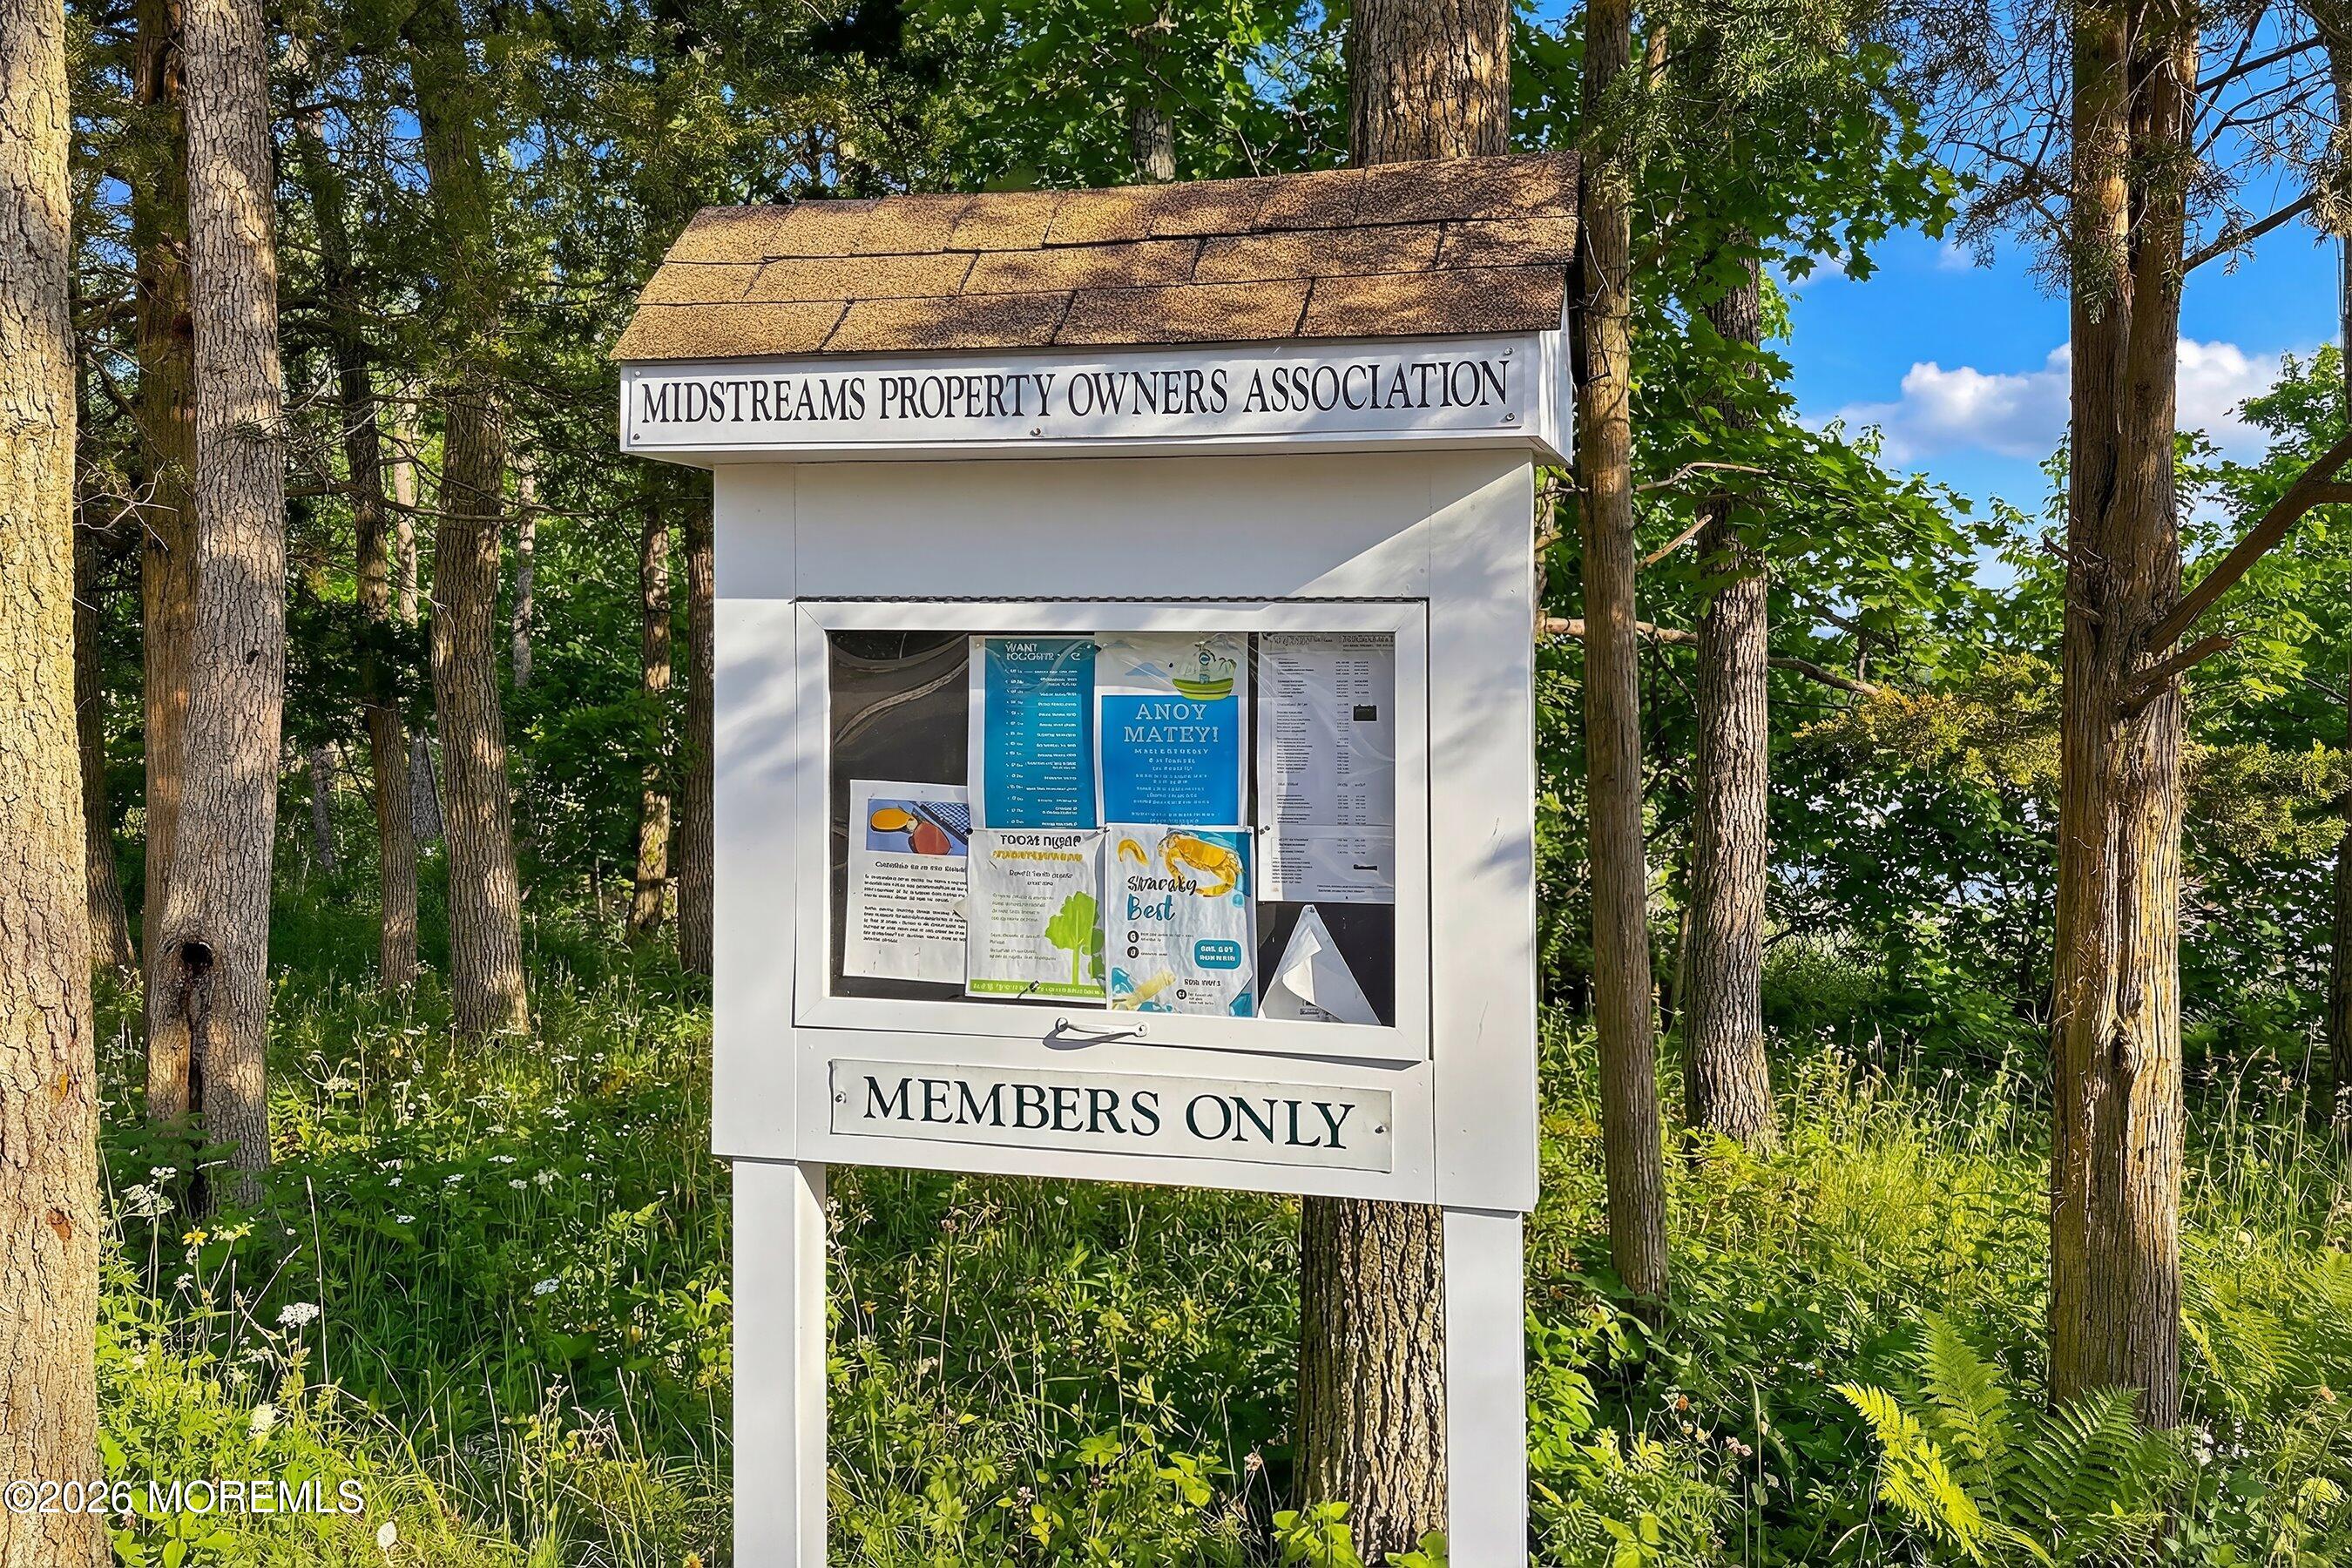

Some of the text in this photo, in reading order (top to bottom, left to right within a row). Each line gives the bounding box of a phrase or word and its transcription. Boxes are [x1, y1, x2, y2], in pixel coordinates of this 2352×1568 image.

[642, 360, 1510, 423] MIDSTREAMS PROPERTY OWNERS ASSOCIATION
[1127, 893, 1176, 921] Best
[863, 1076, 1356, 1149] MEMBERS ONLY
